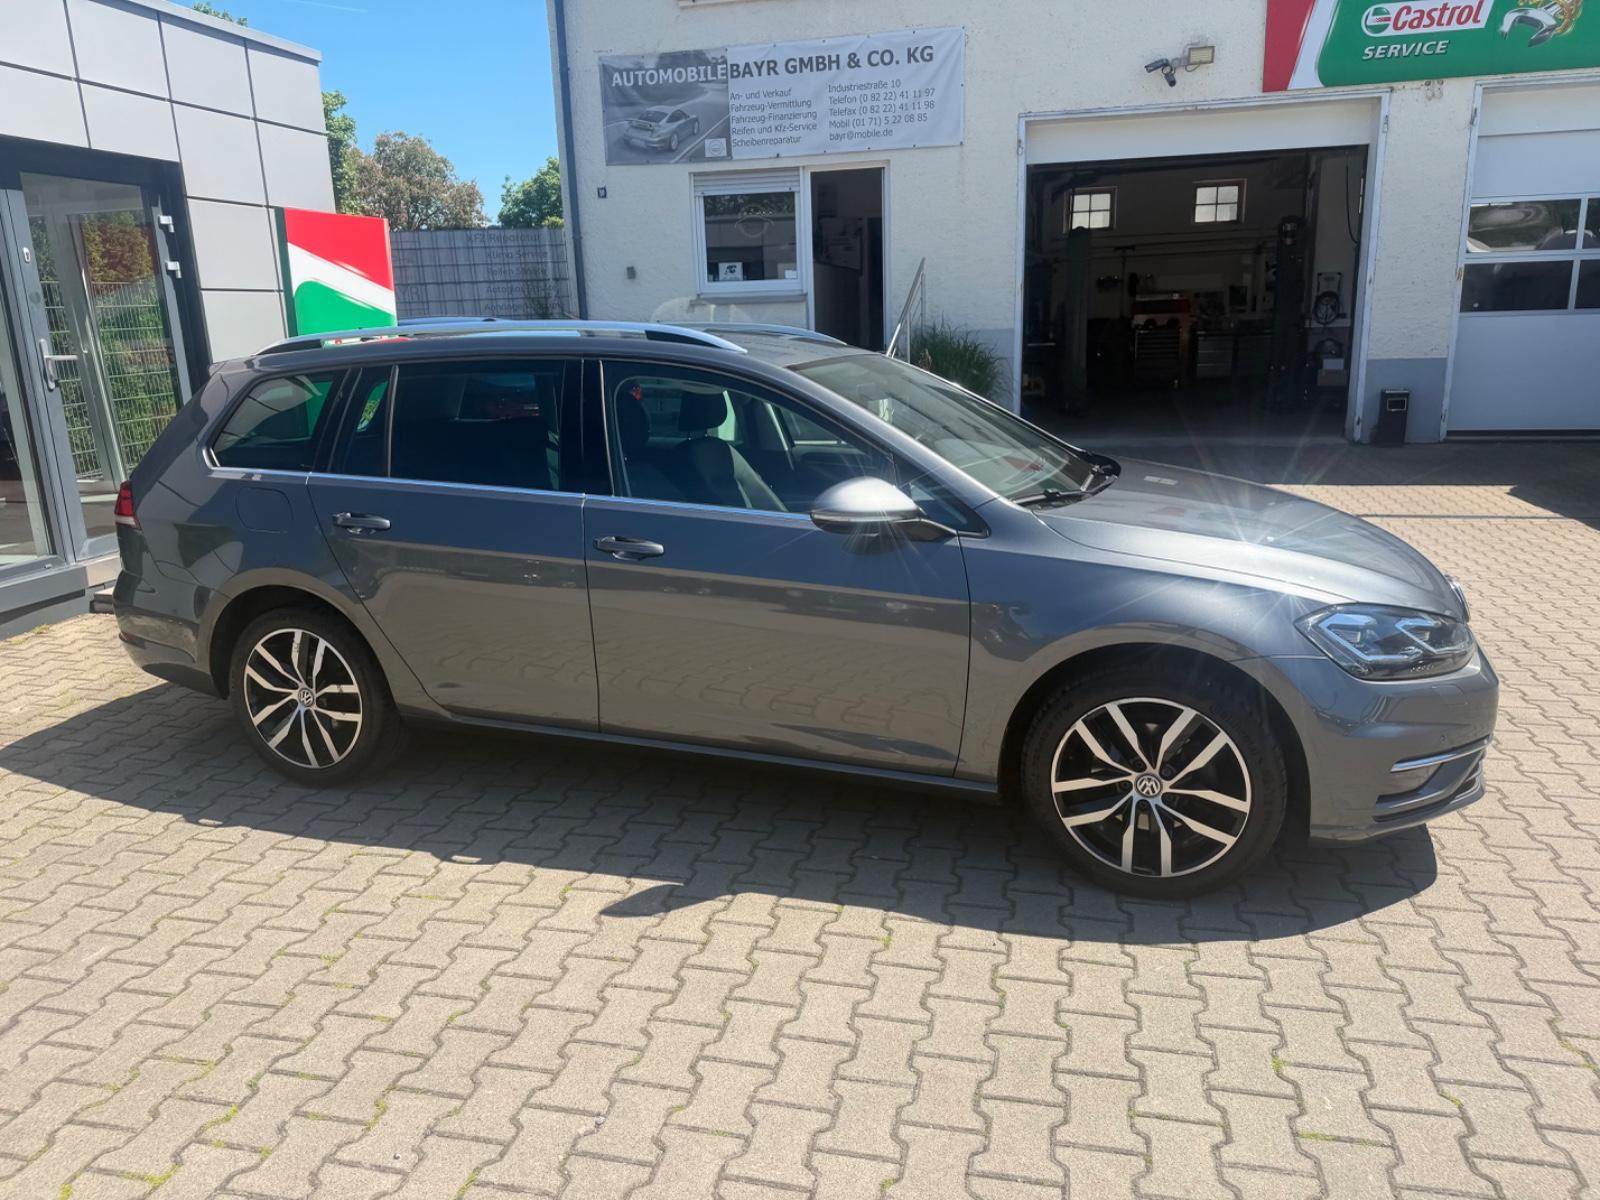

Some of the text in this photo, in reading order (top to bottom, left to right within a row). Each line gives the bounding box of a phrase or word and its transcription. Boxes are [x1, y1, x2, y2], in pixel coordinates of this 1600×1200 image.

[1392, 0, 1485, 31] Castrol
[1362, 40, 1449, 60] SERVICE
[611, 45, 934, 87] AUTOMOBILE BAYR GMBH & CO. KG
[745, 90, 760, 99] und
[762, 87, 792, 98] Verkauf
[828, 78, 902, 93] Industriestraße 10
[828, 88, 936, 105] Telefon (0 82 22) 41 11 97
[730, 99, 813, 113] Fahrzeug-Vermittlung
[828, 106, 857, 117] Telefax
[859, 105, 868, 116] (0
[870, 104, 880, 114] 82
[883, 103, 897, 114] 22)
[899, 102, 909, 111] 41
[912, 101, 921, 110] 11
[731, 110, 818, 125] Fahrzeug-Finanzierung
[828, 118, 850, 129] Mobil
[852, 117, 866, 129] (01
[868, 116, 881, 128] 71)
[884, 115, 890, 125] 5
[892, 114, 902, 124] 22
[732, 122, 817, 135] Reifen und Kfz-Service
[829, 128, 893, 142] bayr@mobile.de
[732, 135, 801, 147] Scheibenreparatur
